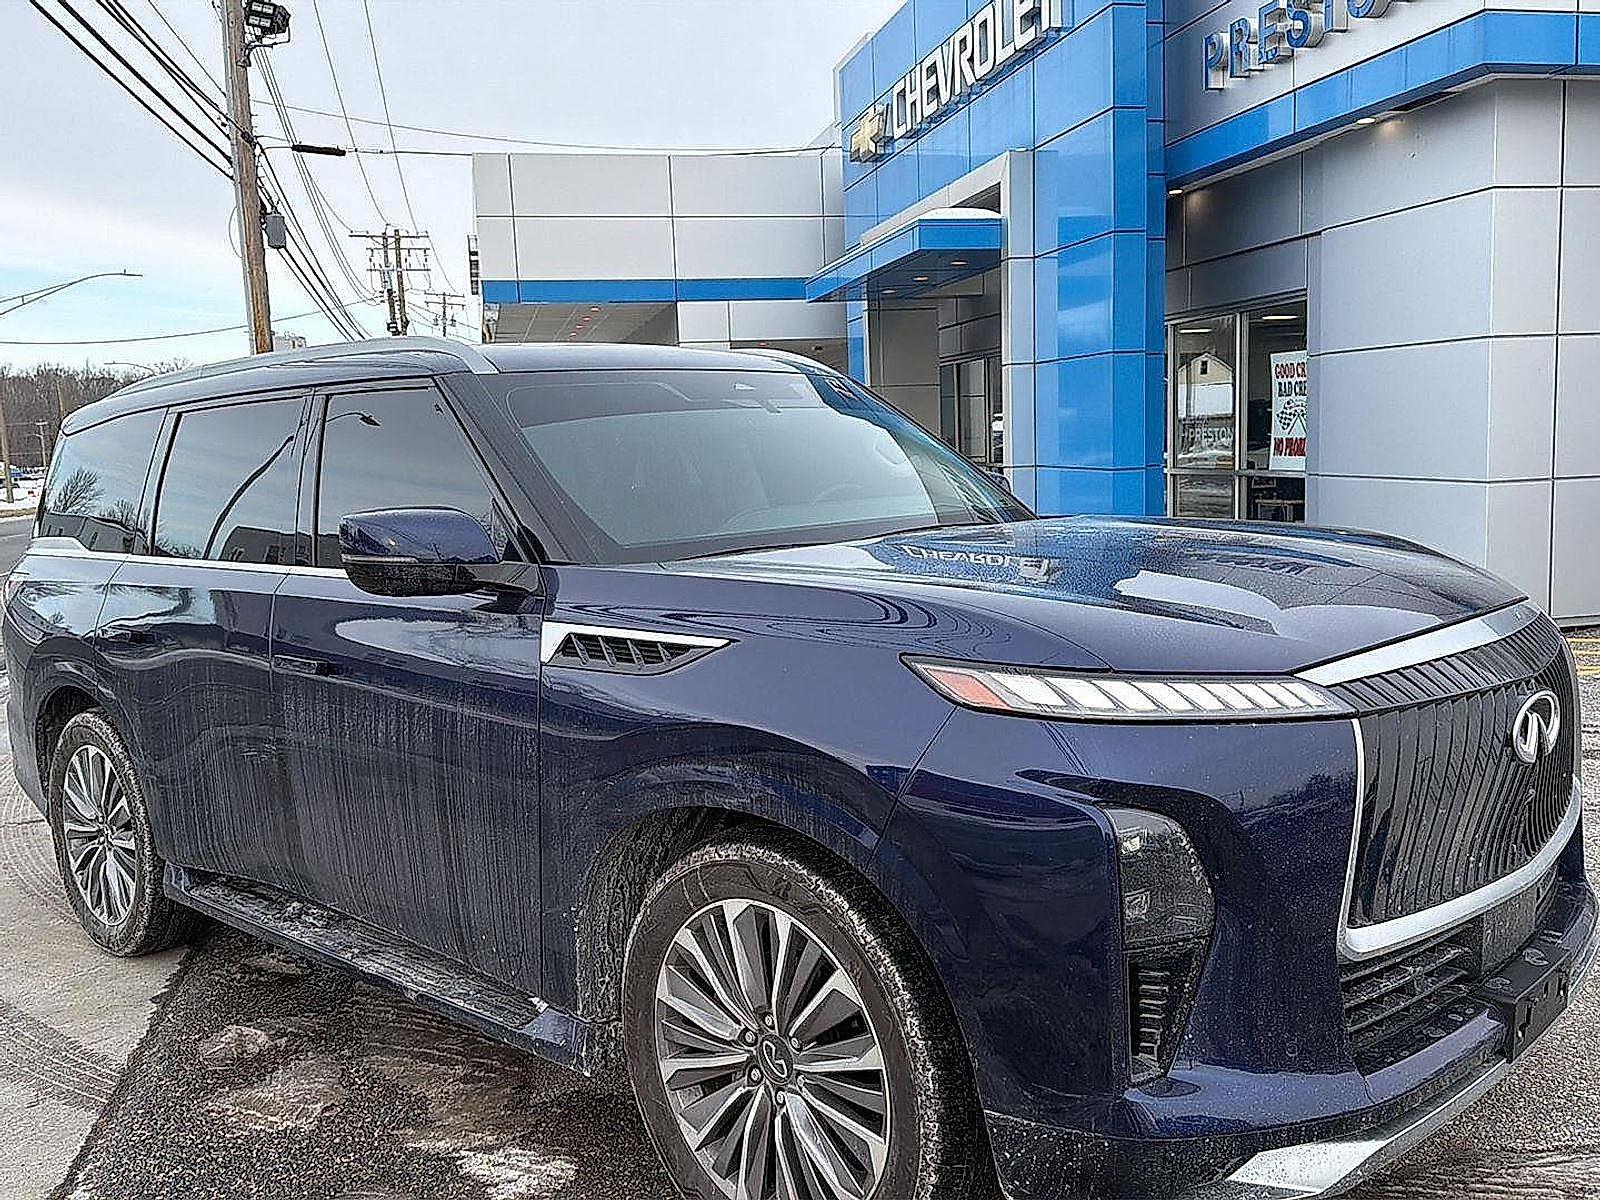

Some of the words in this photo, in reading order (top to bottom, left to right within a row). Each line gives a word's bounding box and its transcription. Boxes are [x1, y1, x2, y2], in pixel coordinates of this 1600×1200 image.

[1275, 362, 1295, 379] GOOD
[1278, 381, 1293, 397] BAD
[1273, 437, 1284, 456] NO
